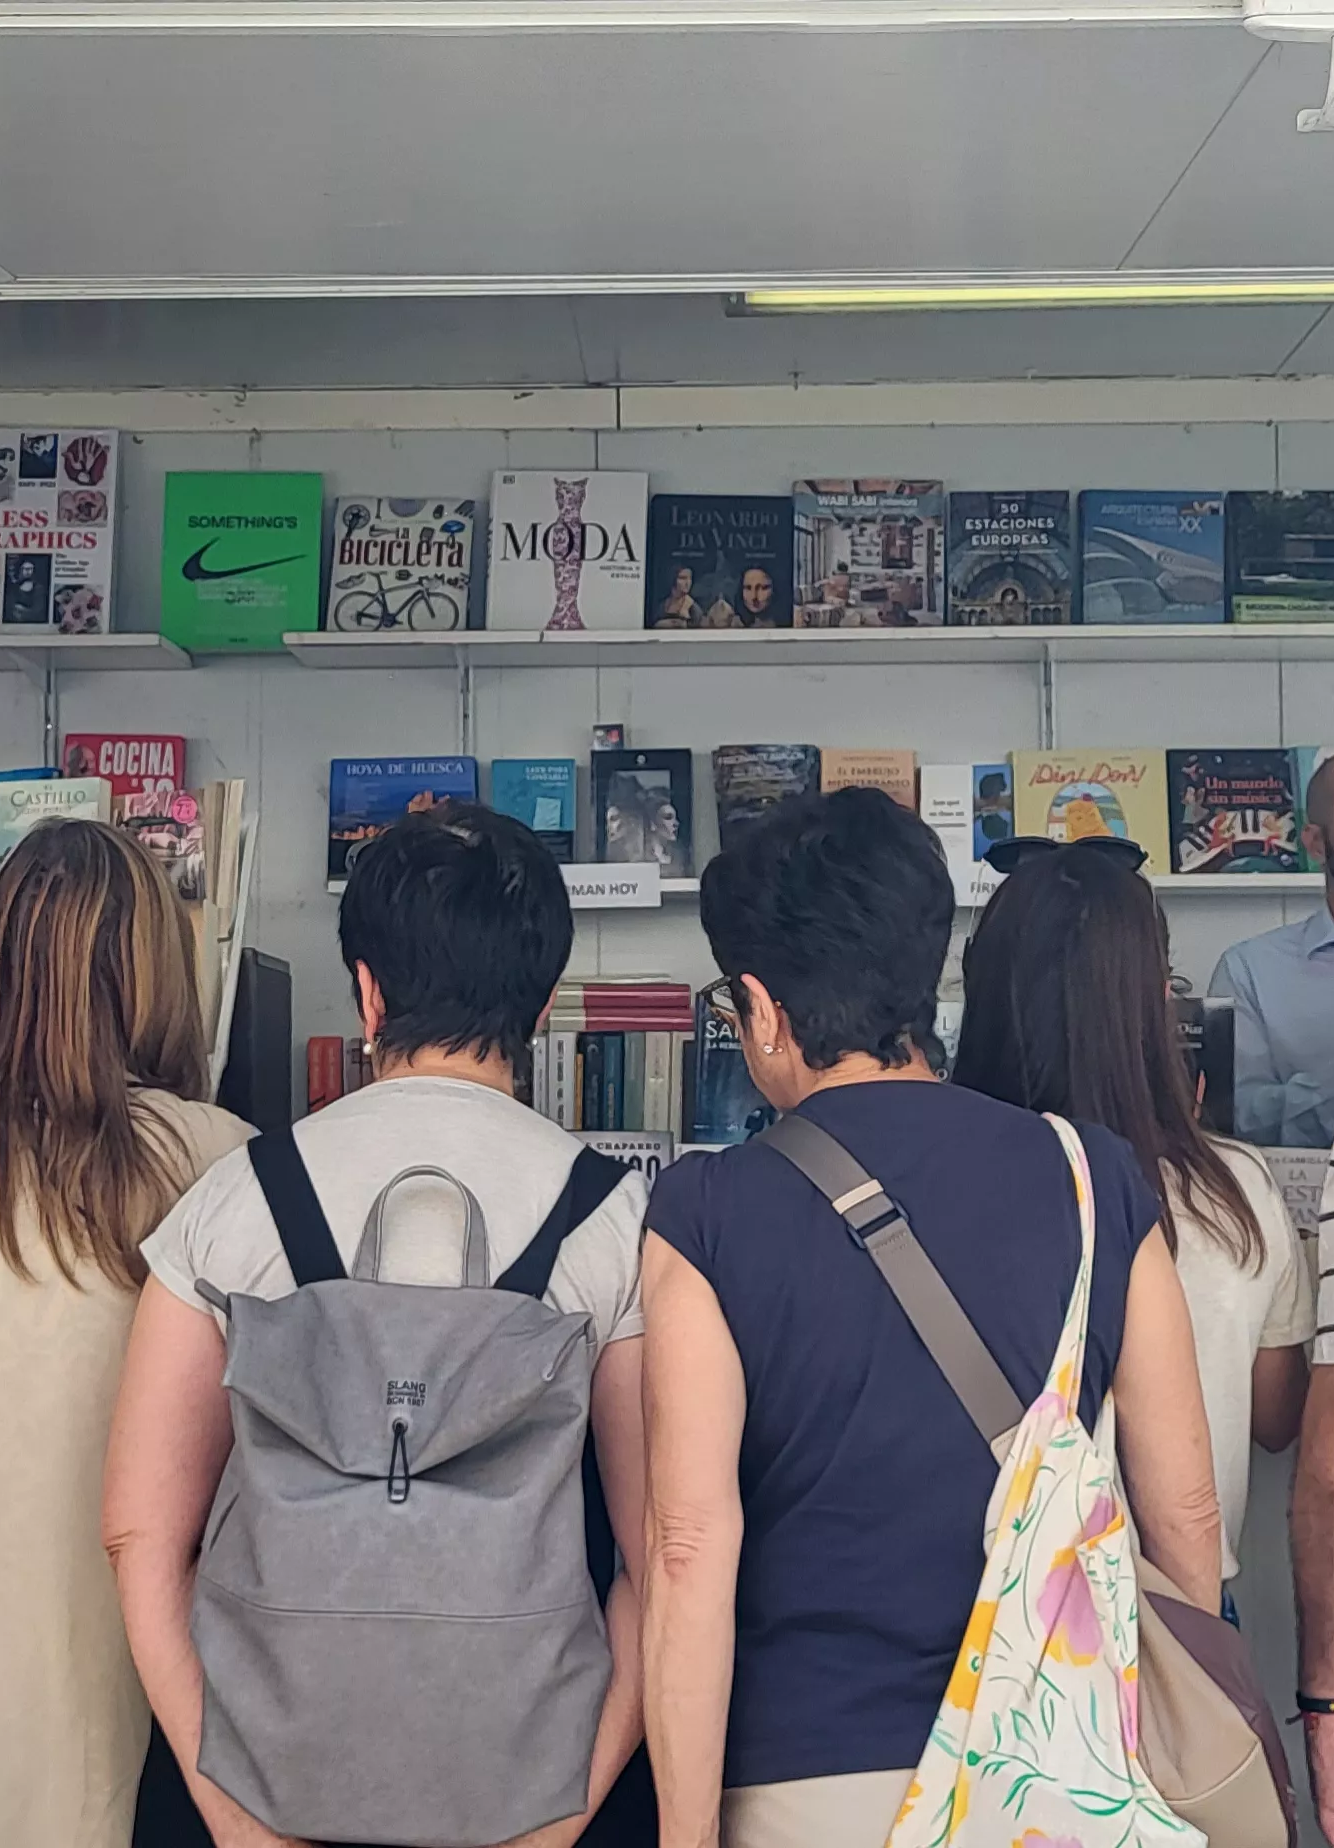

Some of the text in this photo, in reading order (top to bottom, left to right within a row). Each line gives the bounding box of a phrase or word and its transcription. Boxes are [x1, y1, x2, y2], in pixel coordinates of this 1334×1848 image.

[671, 505, 779, 528] LEONARDO
[1000, 503, 1019, 515] 50
[188, 514, 298, 530] SOMETHING'S
[965, 518, 1055, 531] ESTACIONES
[500, 522, 641, 563] MODA
[713, 528, 768, 550] VINCI
[971, 534, 1049, 547] EUROPEAS
[98, 740, 175, 777] COCINA
[346, 761, 464, 776] HOYA DE HUESCA
[1205, 775, 1284, 790] Un mundo
[569, 882, 639, 896] MAN HOY
[595, 1142, 661, 1151] CHAPARRO
[387, 1380, 426, 1394] SLANG
